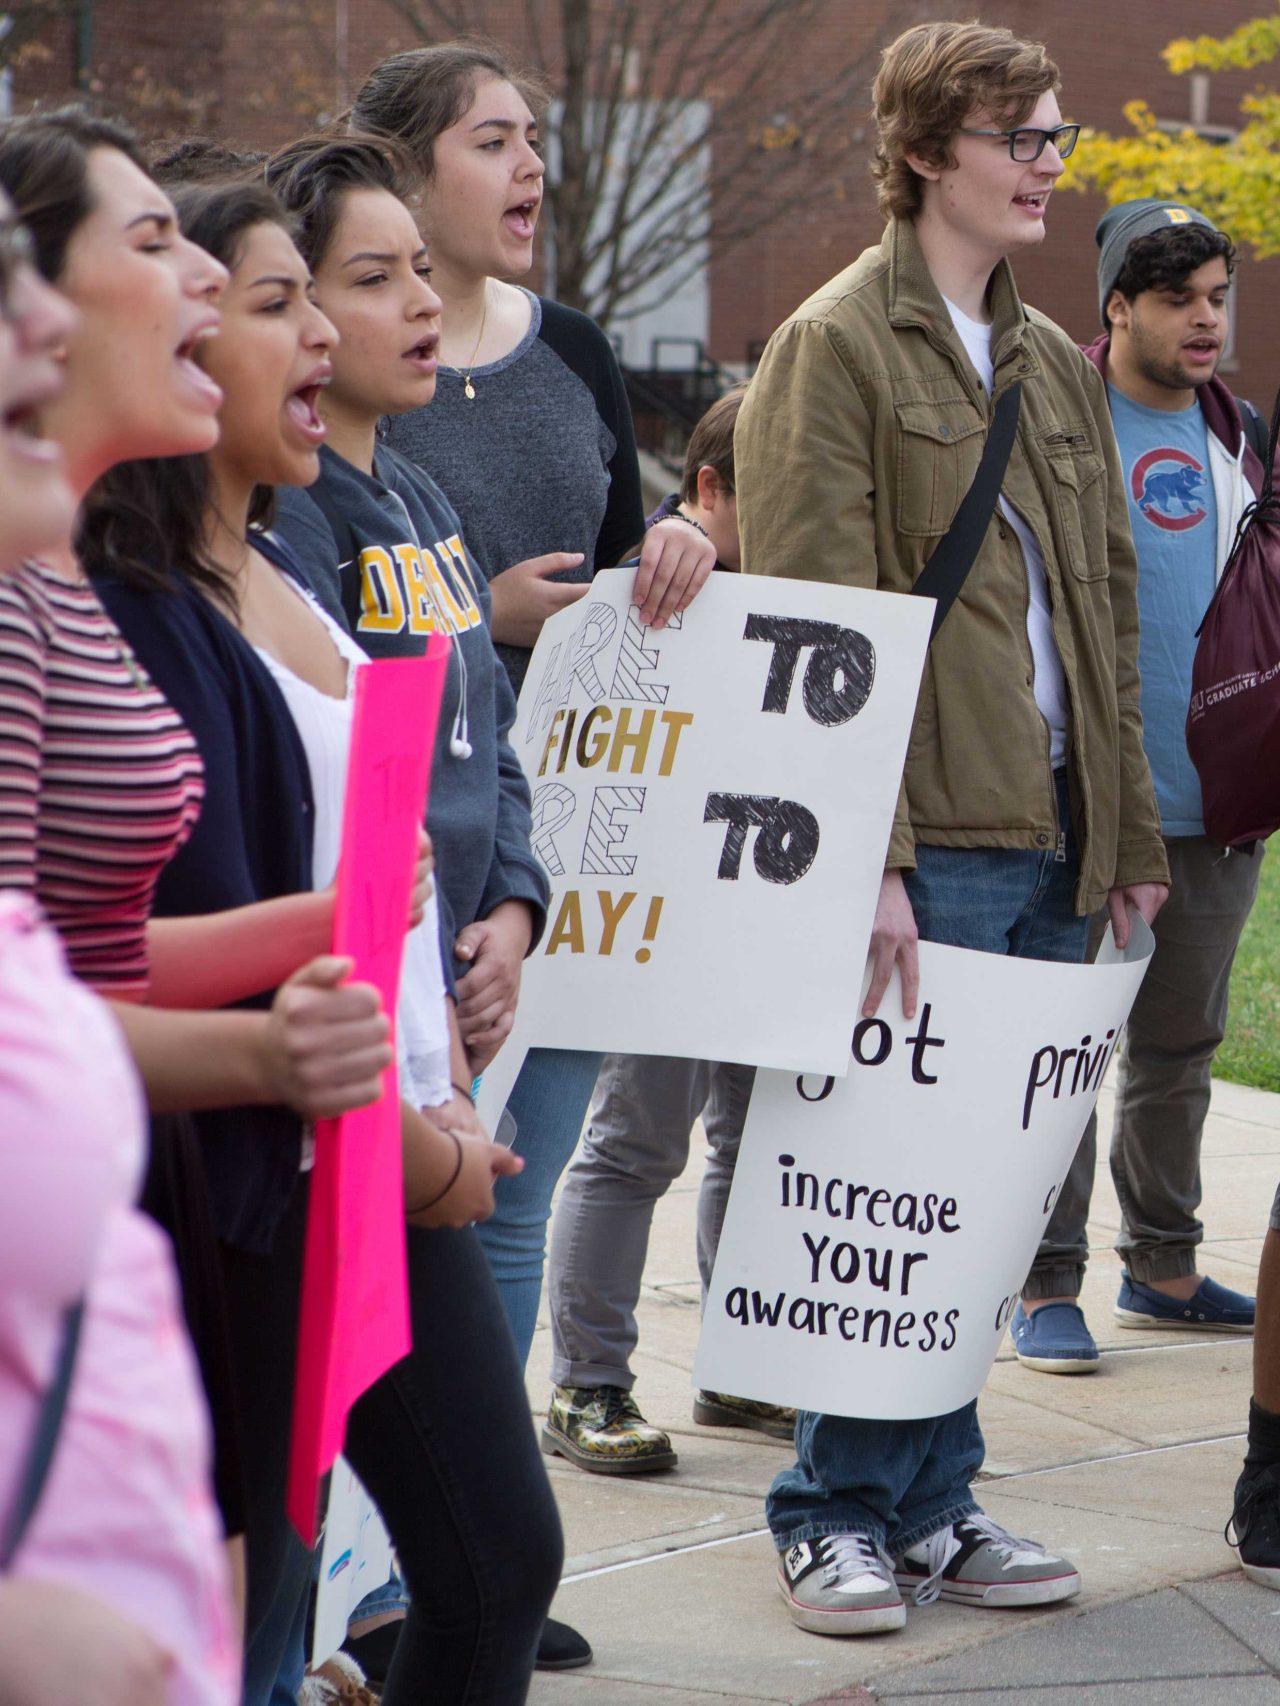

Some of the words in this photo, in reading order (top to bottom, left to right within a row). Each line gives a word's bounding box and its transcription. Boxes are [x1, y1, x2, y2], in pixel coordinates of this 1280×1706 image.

[743, 613, 876, 728] TO
[1206, 678, 1257, 705] GRADUATE
[537, 705, 695, 777] FIGHT
[703, 792, 820, 886] TO
[544, 890, 665, 964] AY!
[778, 1154, 961, 1236] increase
[724, 1286, 960, 1353] awareness
